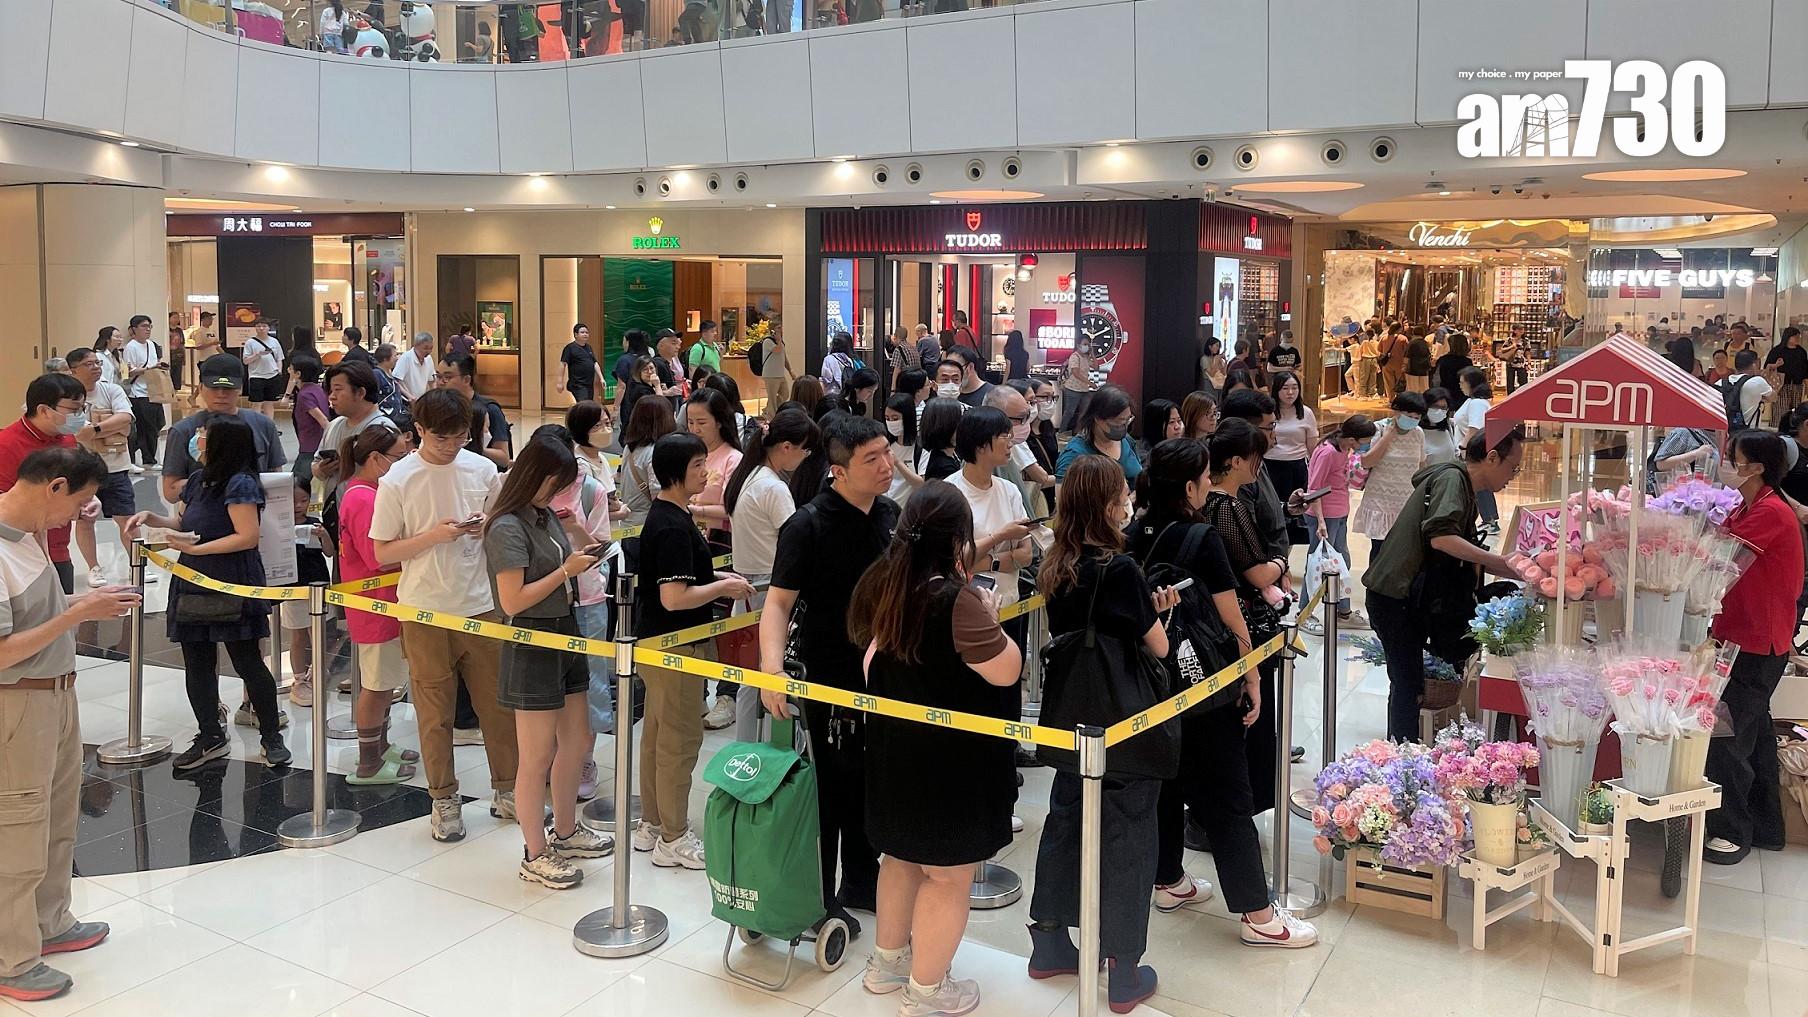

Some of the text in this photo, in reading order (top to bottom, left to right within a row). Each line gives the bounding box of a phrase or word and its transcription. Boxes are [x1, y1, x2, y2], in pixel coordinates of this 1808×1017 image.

[223, 218, 262, 232] 周大福
[945, 234, 1002, 247] TUDOR
[1409, 221, 1472, 246] Venchi
[632, 237, 680, 249] ROLEX
[1612, 270, 1754, 287] FIVE GUYS
[1042, 292, 1076, 302] TUDO
[1178, 658, 1189, 679] THE
[1186, 657, 1199, 687] ORTH
[728, 755, 758, 777] Dettol
[1669, 803, 1684, 813] Home
[1689, 800, 1706, 812] Garden
